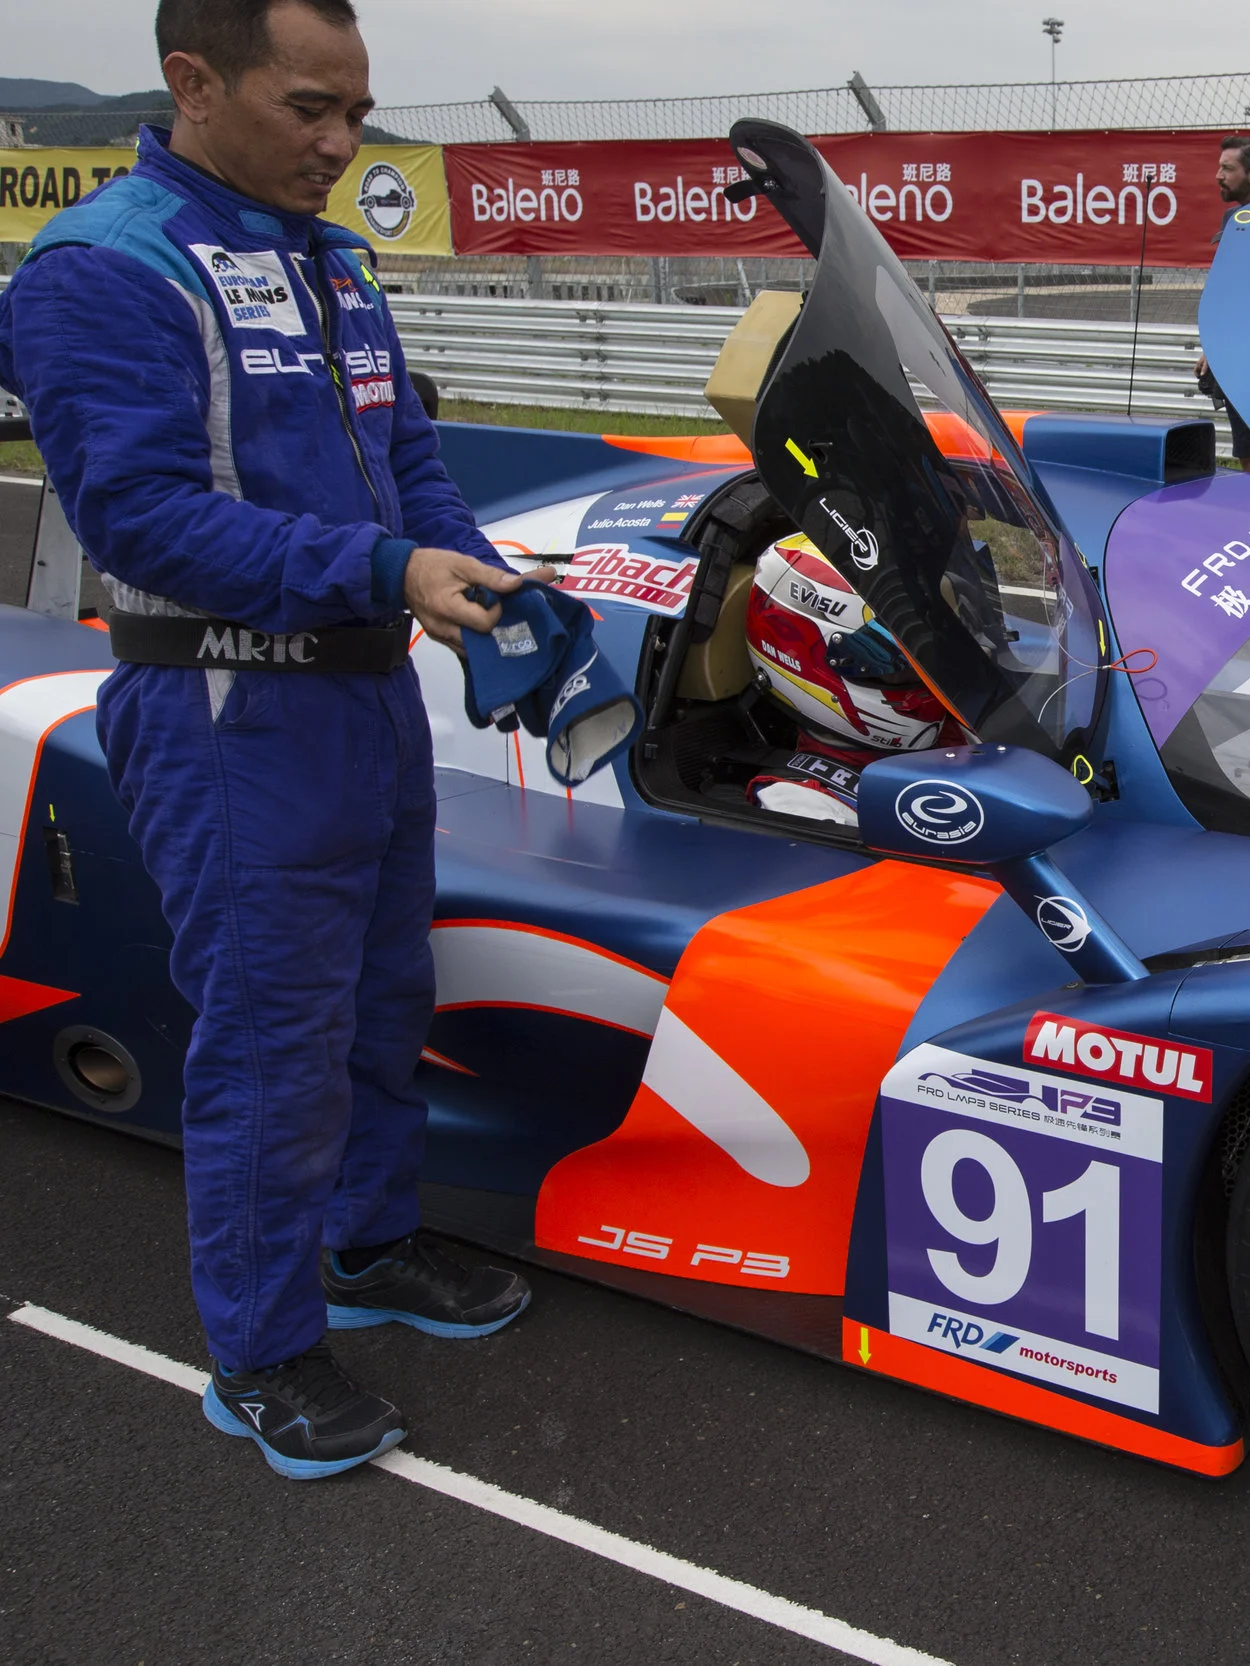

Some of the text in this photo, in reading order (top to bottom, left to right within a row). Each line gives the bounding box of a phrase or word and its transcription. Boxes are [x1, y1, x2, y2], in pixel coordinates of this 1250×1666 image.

[0, 166, 81, 208] ROAD
[540, 169, 581, 186] 班尼路
[902, 163, 951, 182] 班尼路
[1122, 163, 1177, 183] 班尼路
[472, 176, 584, 222] Baleno
[1021, 172, 1177, 226] Baleno
[224, 288, 244, 305] LE
[587, 516, 652, 530] Julio Acosta
[613, 499, 667, 511] Dan Wells
[819, 497, 868, 554] LIGIER
[789, 581, 848, 617] EVISU
[761, 639, 801, 672] DAN WELLS
[1031, 1020, 1204, 1093] MOTUL
[917, 1084, 945, 1099] FRD
[947, 1090, 986, 1108] LMP3
[989, 1100, 1041, 1122] SERIES
[577, 1224, 791, 1279] JS P3
[920, 1128, 1121, 1341] 91
[926, 1311, 1119, 1384] FRD motorsports
